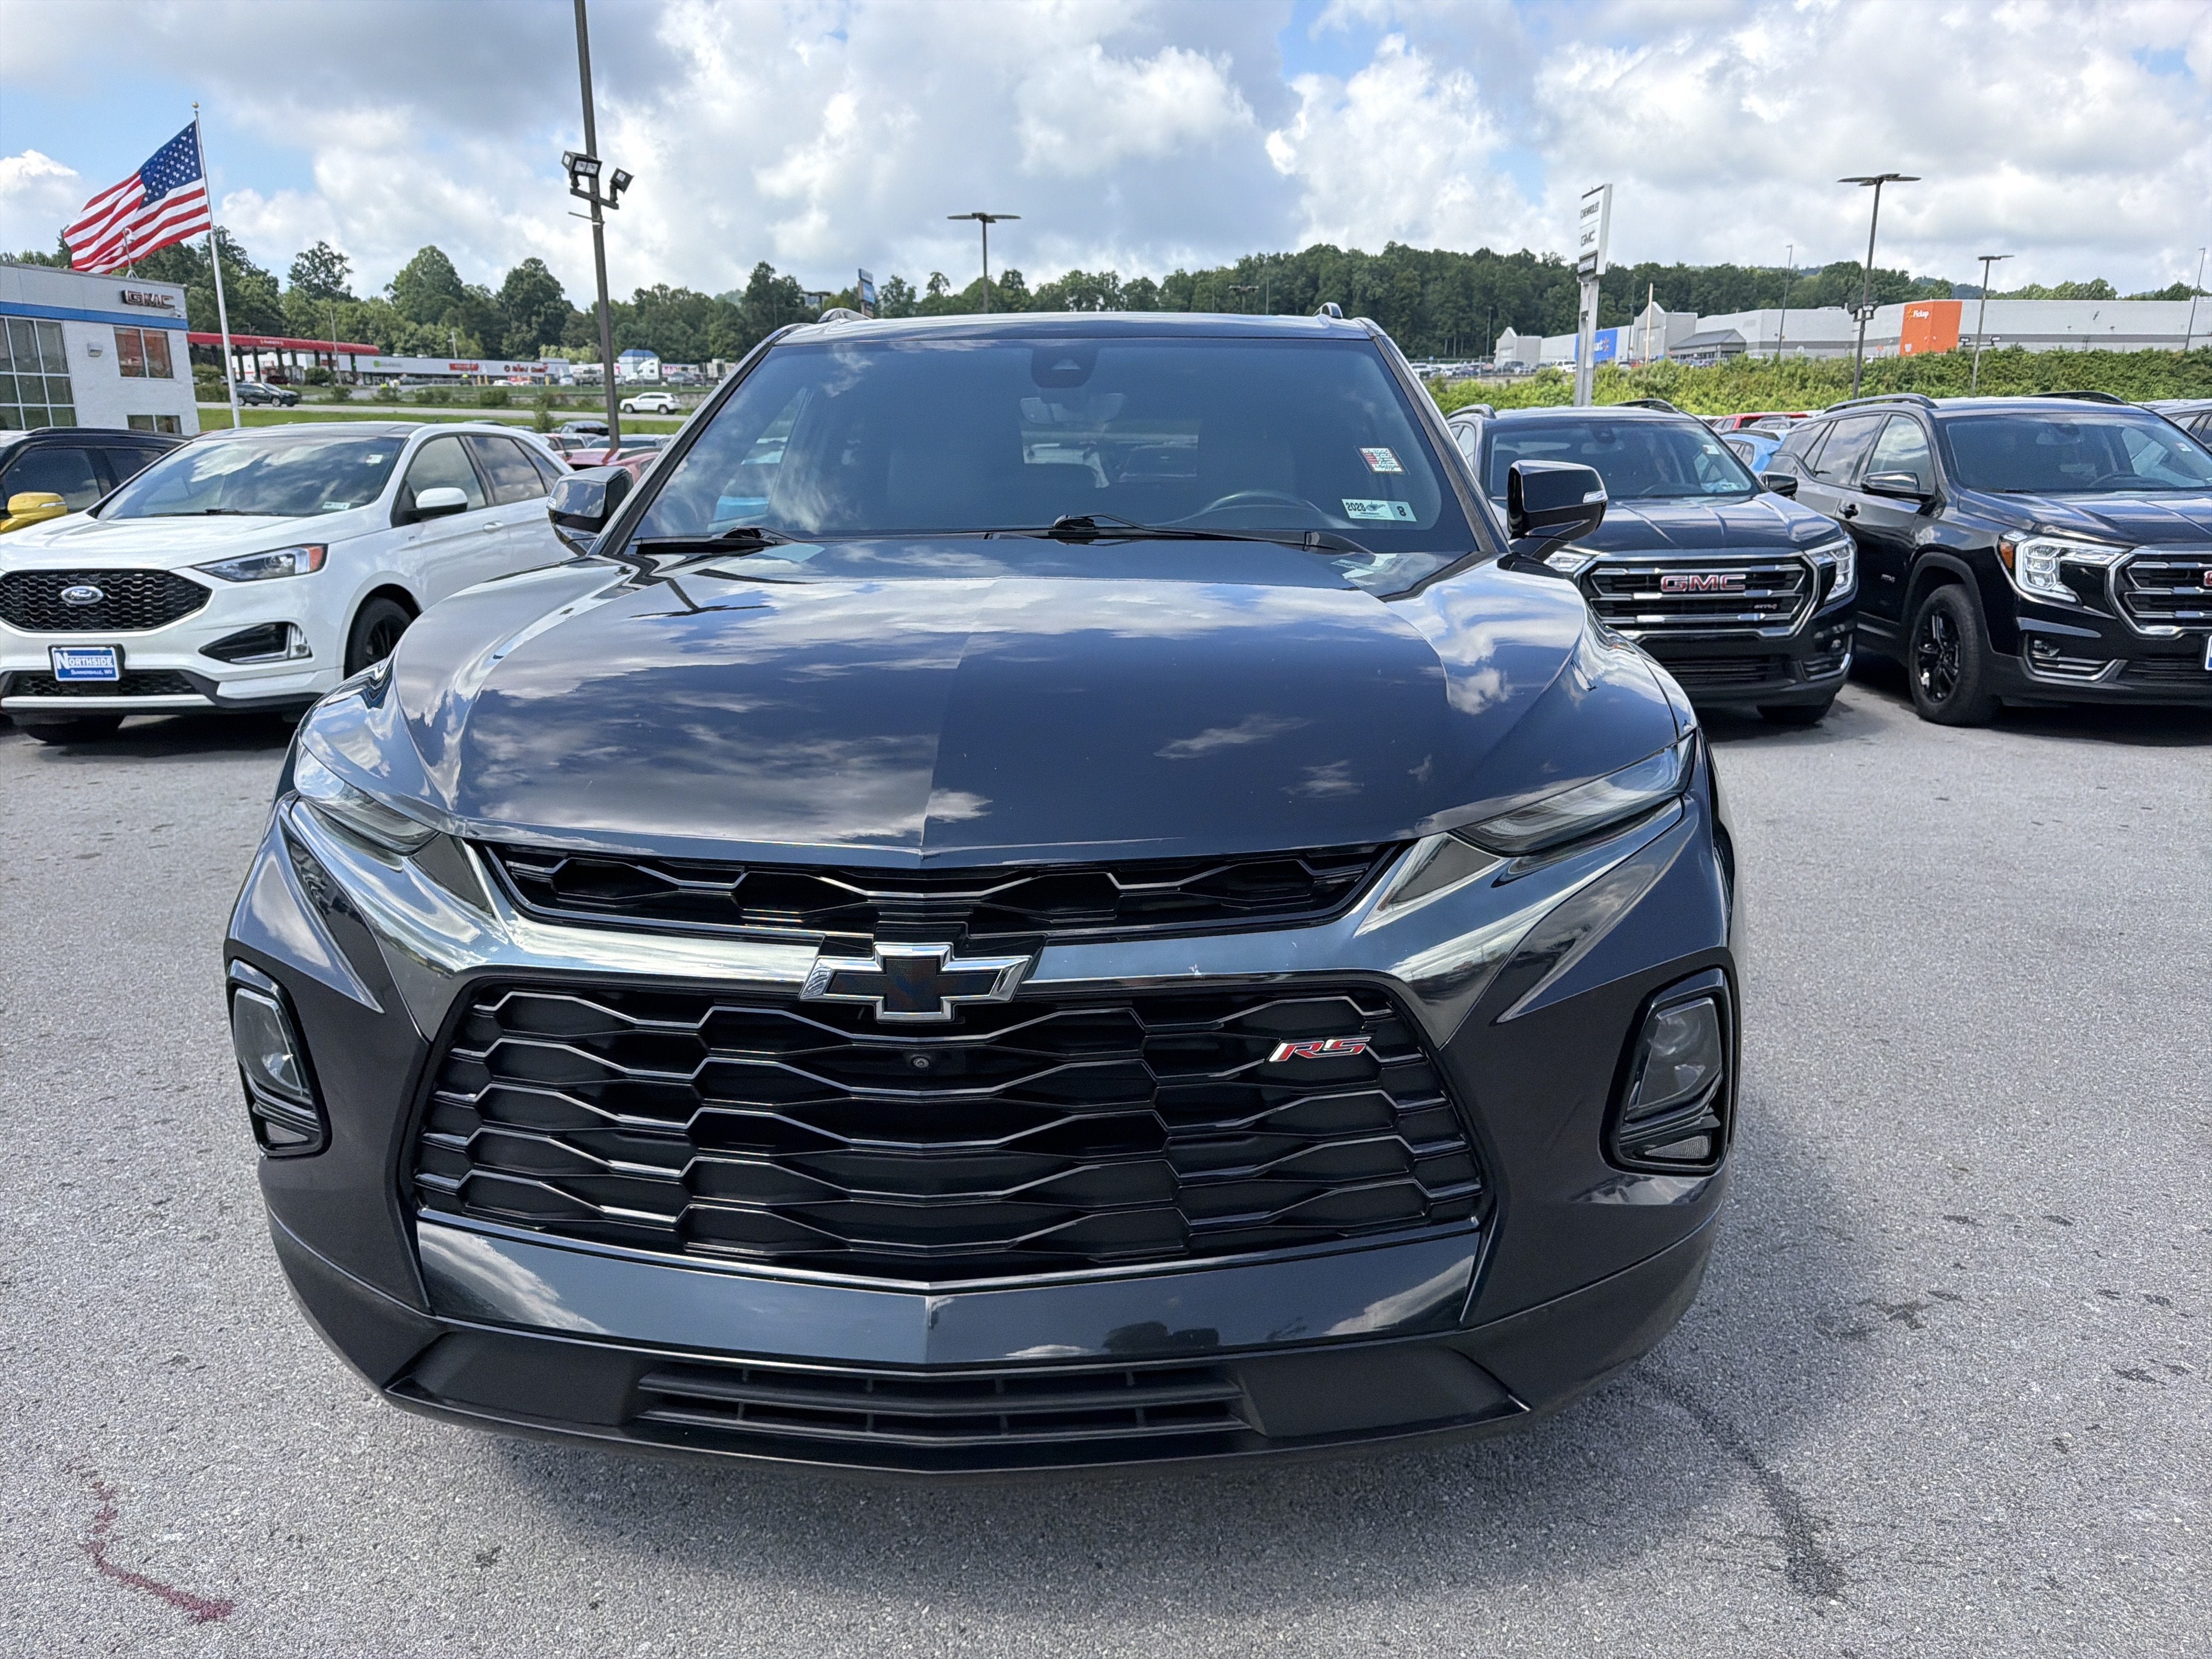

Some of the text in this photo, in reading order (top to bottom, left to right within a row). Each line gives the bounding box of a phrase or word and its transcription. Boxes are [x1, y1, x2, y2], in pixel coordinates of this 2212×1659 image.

[1581, 230, 1595, 247] GMC
[124, 290, 176, 309] GMC
[1913, 309, 1929, 319] Pickup
[1345, 502, 1367, 511] 2028
[1397, 506, 1407, 516] 8
[1661, 574, 1746, 592] GMC
[69, 589, 92, 597] Ford
[55, 652, 112, 669] NORTHSIDE
[1269, 1036, 1372, 1062] RS
